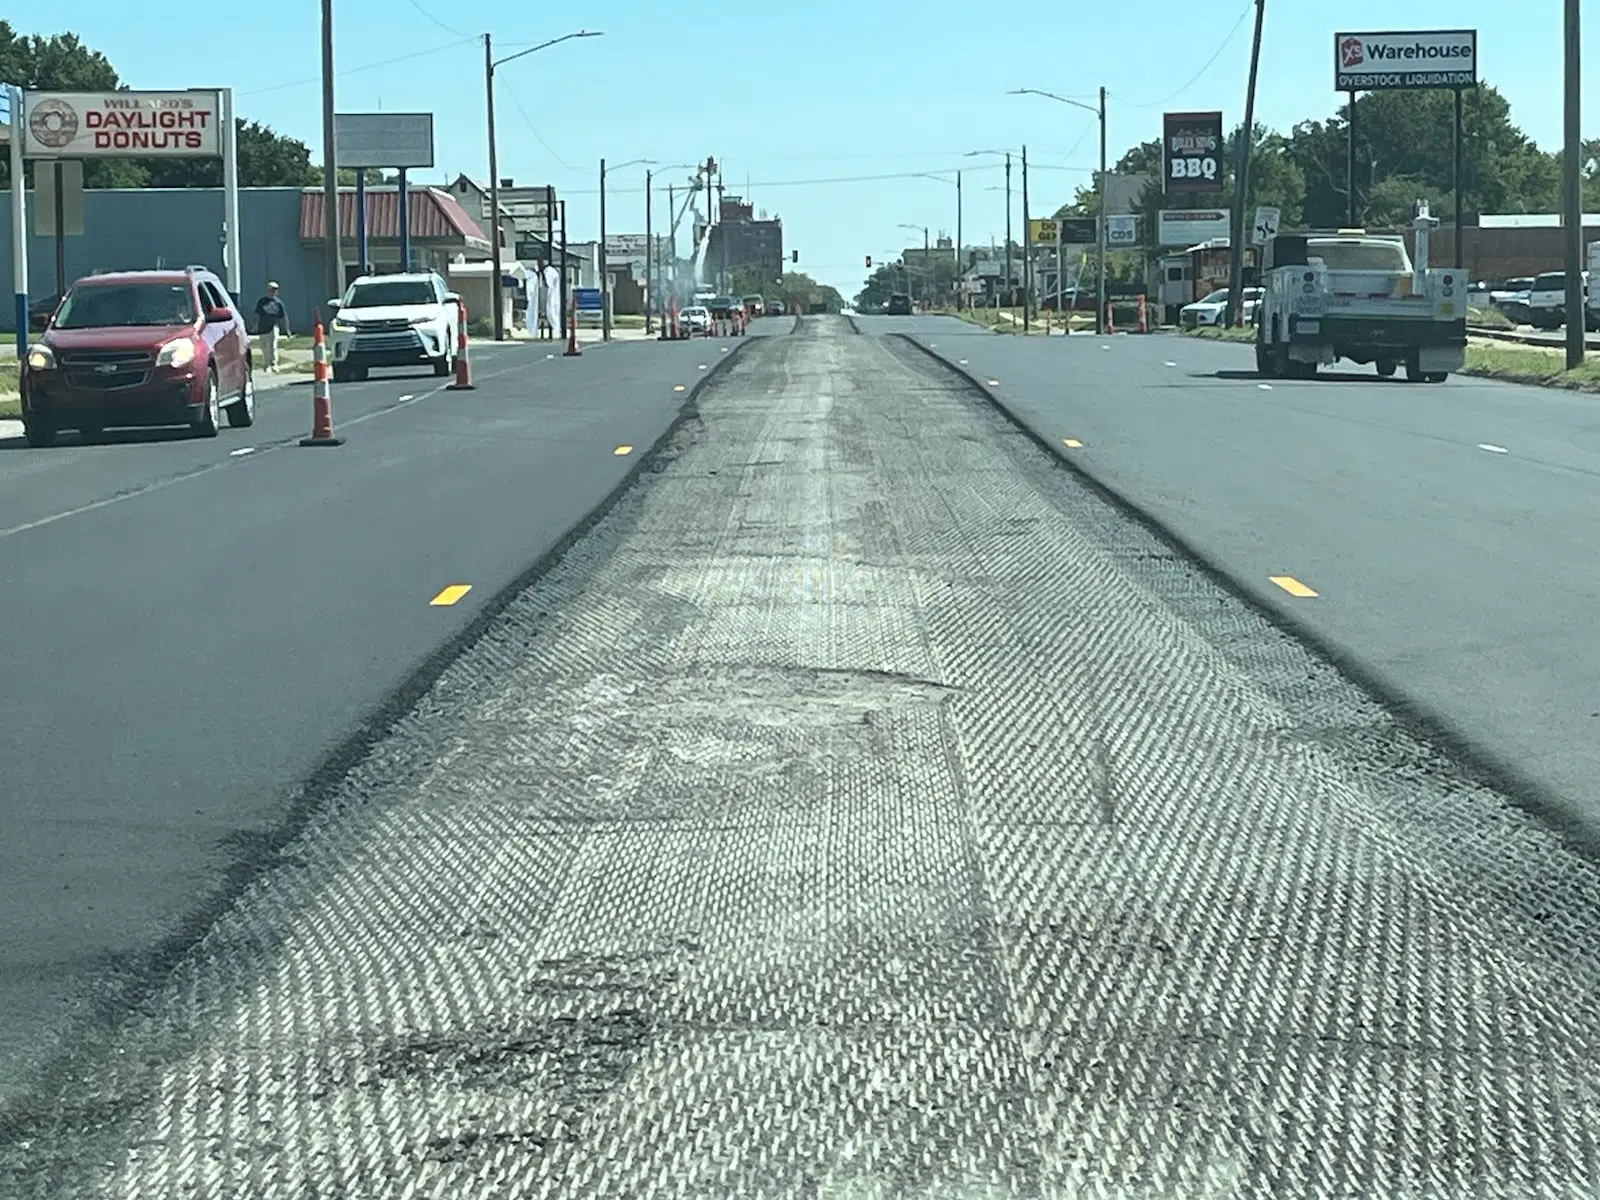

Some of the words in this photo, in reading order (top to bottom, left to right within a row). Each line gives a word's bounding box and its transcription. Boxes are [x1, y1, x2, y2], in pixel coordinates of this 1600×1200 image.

[1366, 42, 1472, 60] Warehouse
[1338, 74, 1402, 86] OVERSTOCK
[1405, 72, 1473, 85] LIQUIDATION
[86, 111, 211, 128] DAYLIGHT
[95, 131, 201, 148] DONUTS
[1170, 158, 1217, 180] BBQ
